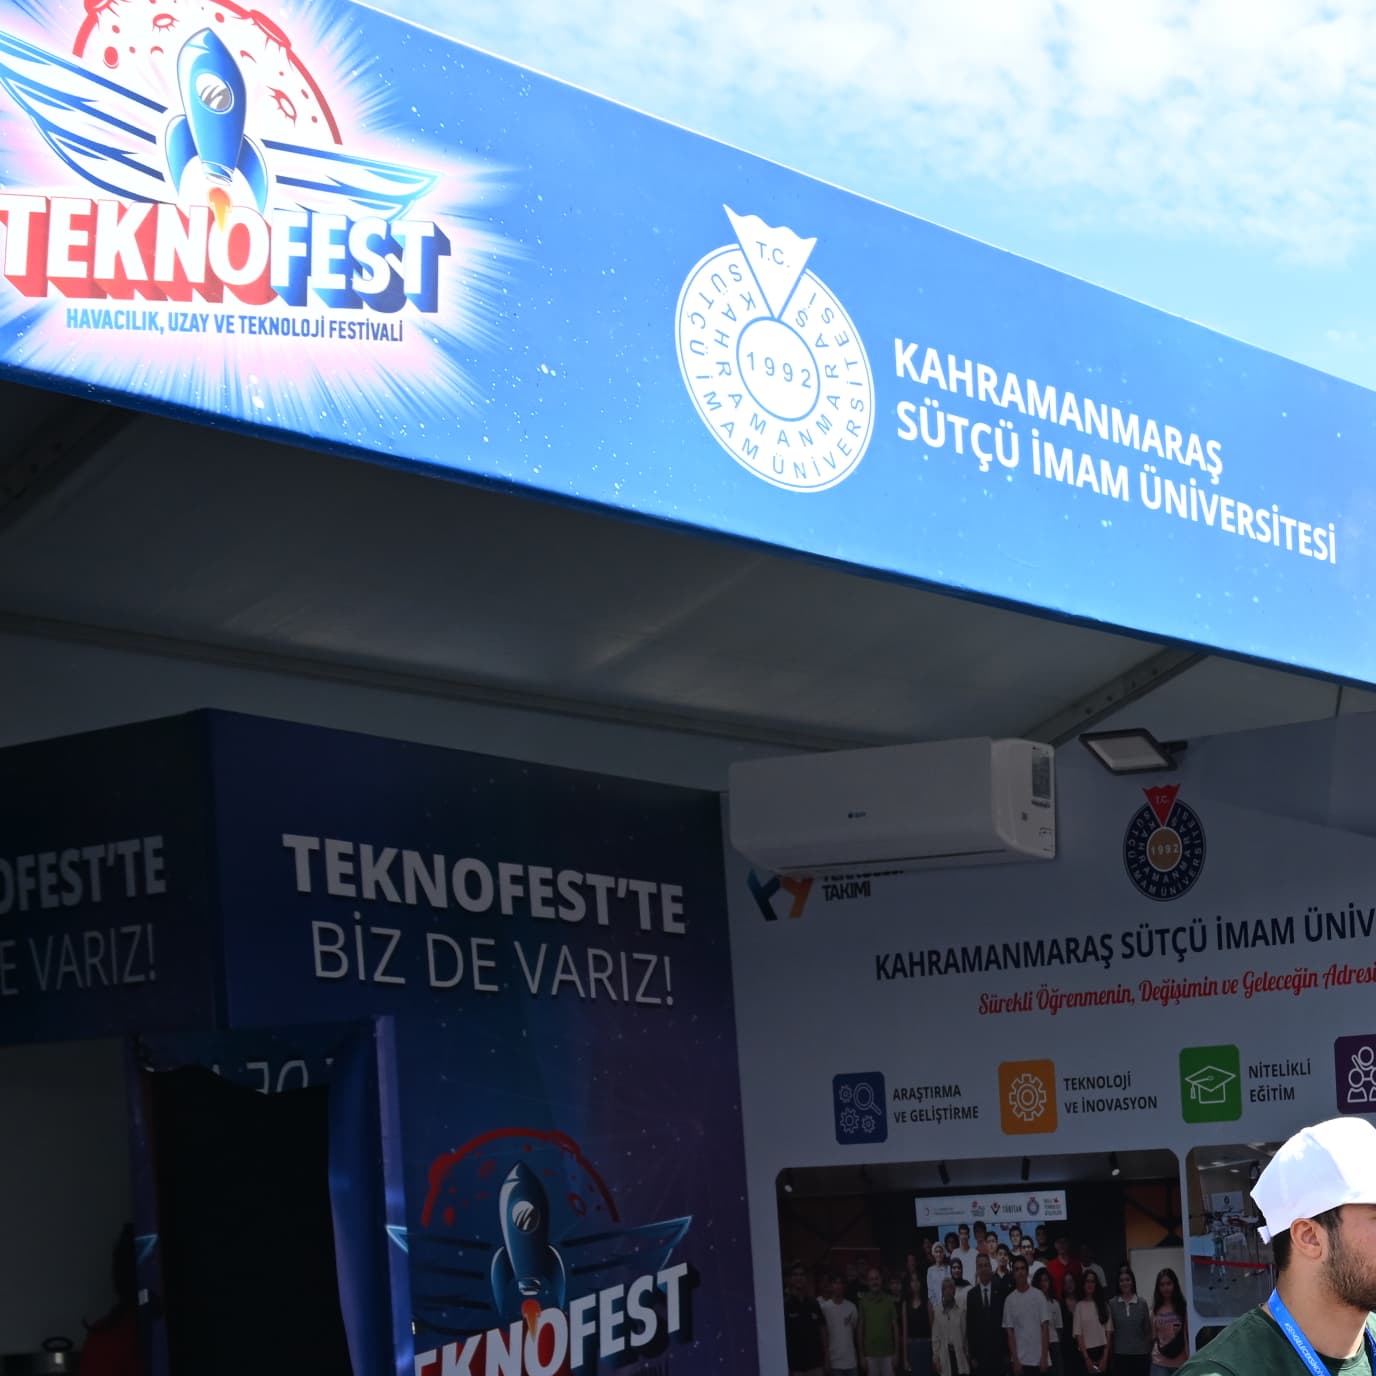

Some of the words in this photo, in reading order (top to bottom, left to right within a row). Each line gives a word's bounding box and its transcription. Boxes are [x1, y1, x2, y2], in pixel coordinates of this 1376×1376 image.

[0, 194, 445, 310] TEKNOFEST
[66, 308, 165, 335] HAVACILIK,
[168, 311, 209, 333] UZAY
[213, 314, 234, 334] VE
[239, 313, 325, 338] TEKNOLOJİ
[329, 318, 403, 343] FESTİVALİ
[747, 352, 812, 388] 1992
[894, 337, 1225, 484] KAHRAMANMARAŞ
[896, 400, 1019, 471] SÜTÇÜ
[1032, 428, 1130, 504] İMAM
[1140, 464, 1336, 565] ÜNİVERSİTESİ
[281, 832, 687, 936] TEKNOFEST'TE
[822, 880, 871, 901] TAKIMI
[27, 922, 158, 992] VARIZ!
[310, 910, 406, 985] BİZ
[426, 930, 499, 994] DE
[514, 938, 674, 1006] VARIZ!
[875, 933, 1114, 980] KAHRAMANMARAŞ
[1121, 917, 1208, 962] SÜTÇÜ
[1216, 915, 1296, 951] İMAM
[978, 988, 1033, 1016] Sürekli
[1036, 984, 1136, 1016] Öğrenmenin,
[1139, 975, 1218, 1007] Değişimin
[1222, 979, 1239, 996] ve
[1243, 967, 1318, 999] Geleceğin
[1063, 1070, 1132, 1092] TEKNOLOJİ
[1248, 1057, 1312, 1079] NİTELİKLİ
[892, 1083, 962, 1104] ARAŞTIRMA
[1064, 1099, 1078, 1113] VE
[1081, 1092, 1158, 1113] İNOVASYON
[1249, 1083, 1296, 1103] EĞİTİM
[893, 1111, 907, 1124] VE
[909, 1103, 980, 1124] GELİŞTİRME
